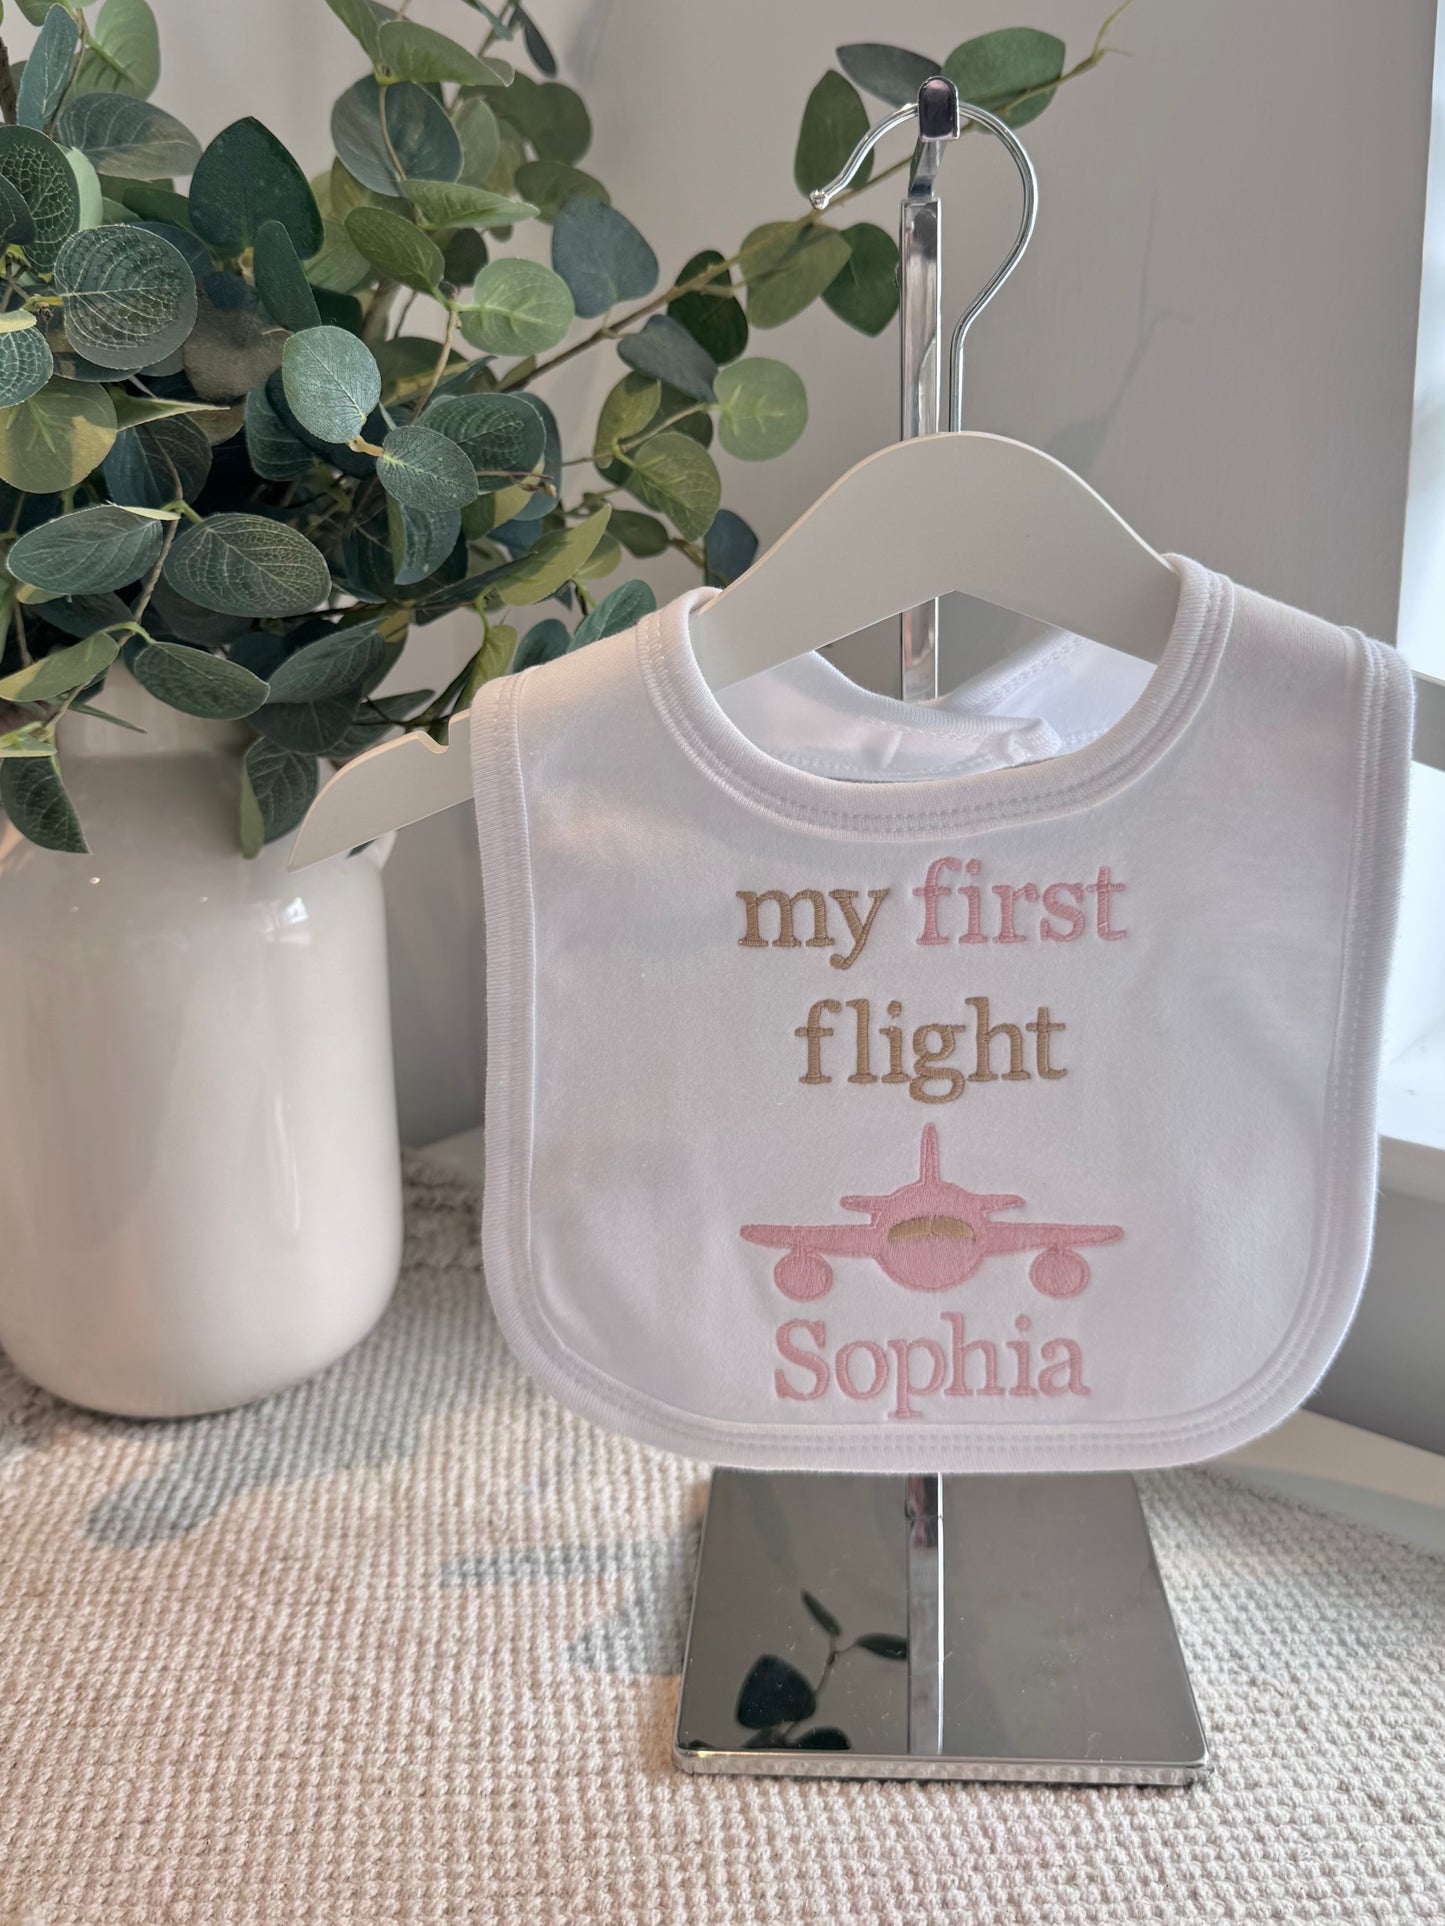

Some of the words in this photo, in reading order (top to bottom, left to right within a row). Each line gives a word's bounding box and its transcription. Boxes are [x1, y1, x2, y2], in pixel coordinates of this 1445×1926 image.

[735, 887, 890, 970] my
[912, 856, 1128, 946] first
[794, 996, 1069, 1104] flight
[773, 1312, 1092, 1420] Sophia
